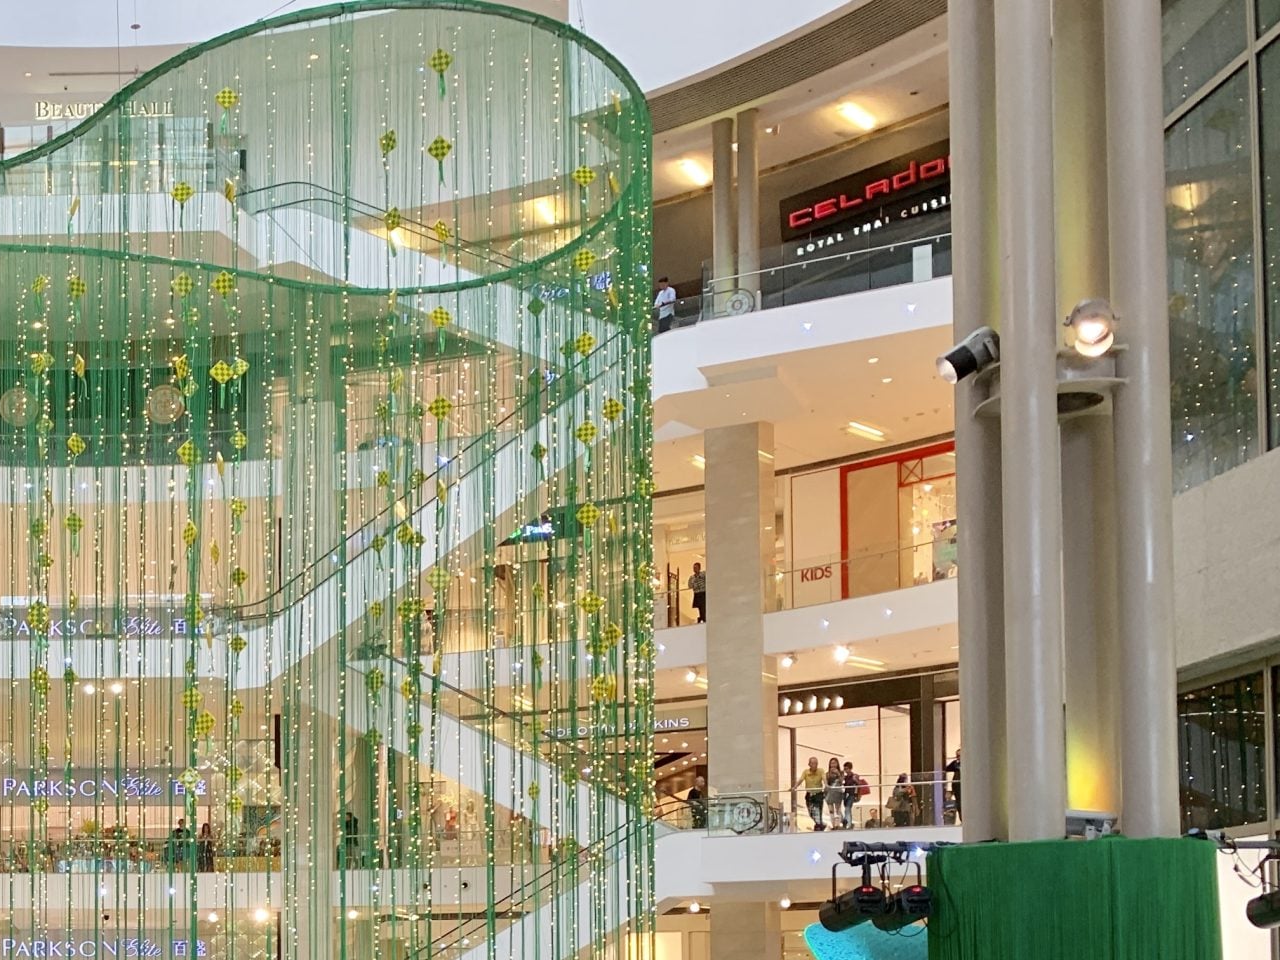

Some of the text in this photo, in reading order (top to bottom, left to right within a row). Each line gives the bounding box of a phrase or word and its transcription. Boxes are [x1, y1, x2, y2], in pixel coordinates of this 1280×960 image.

[121, 100, 175, 118] HALL
[797, 233, 844, 256] ROYAL
[853, 215, 890, 236] THAI
[800, 566, 833, 583] KIDS
[3, 778, 118, 796] PARKSON
[2, 938, 118, 957] PARKSON
